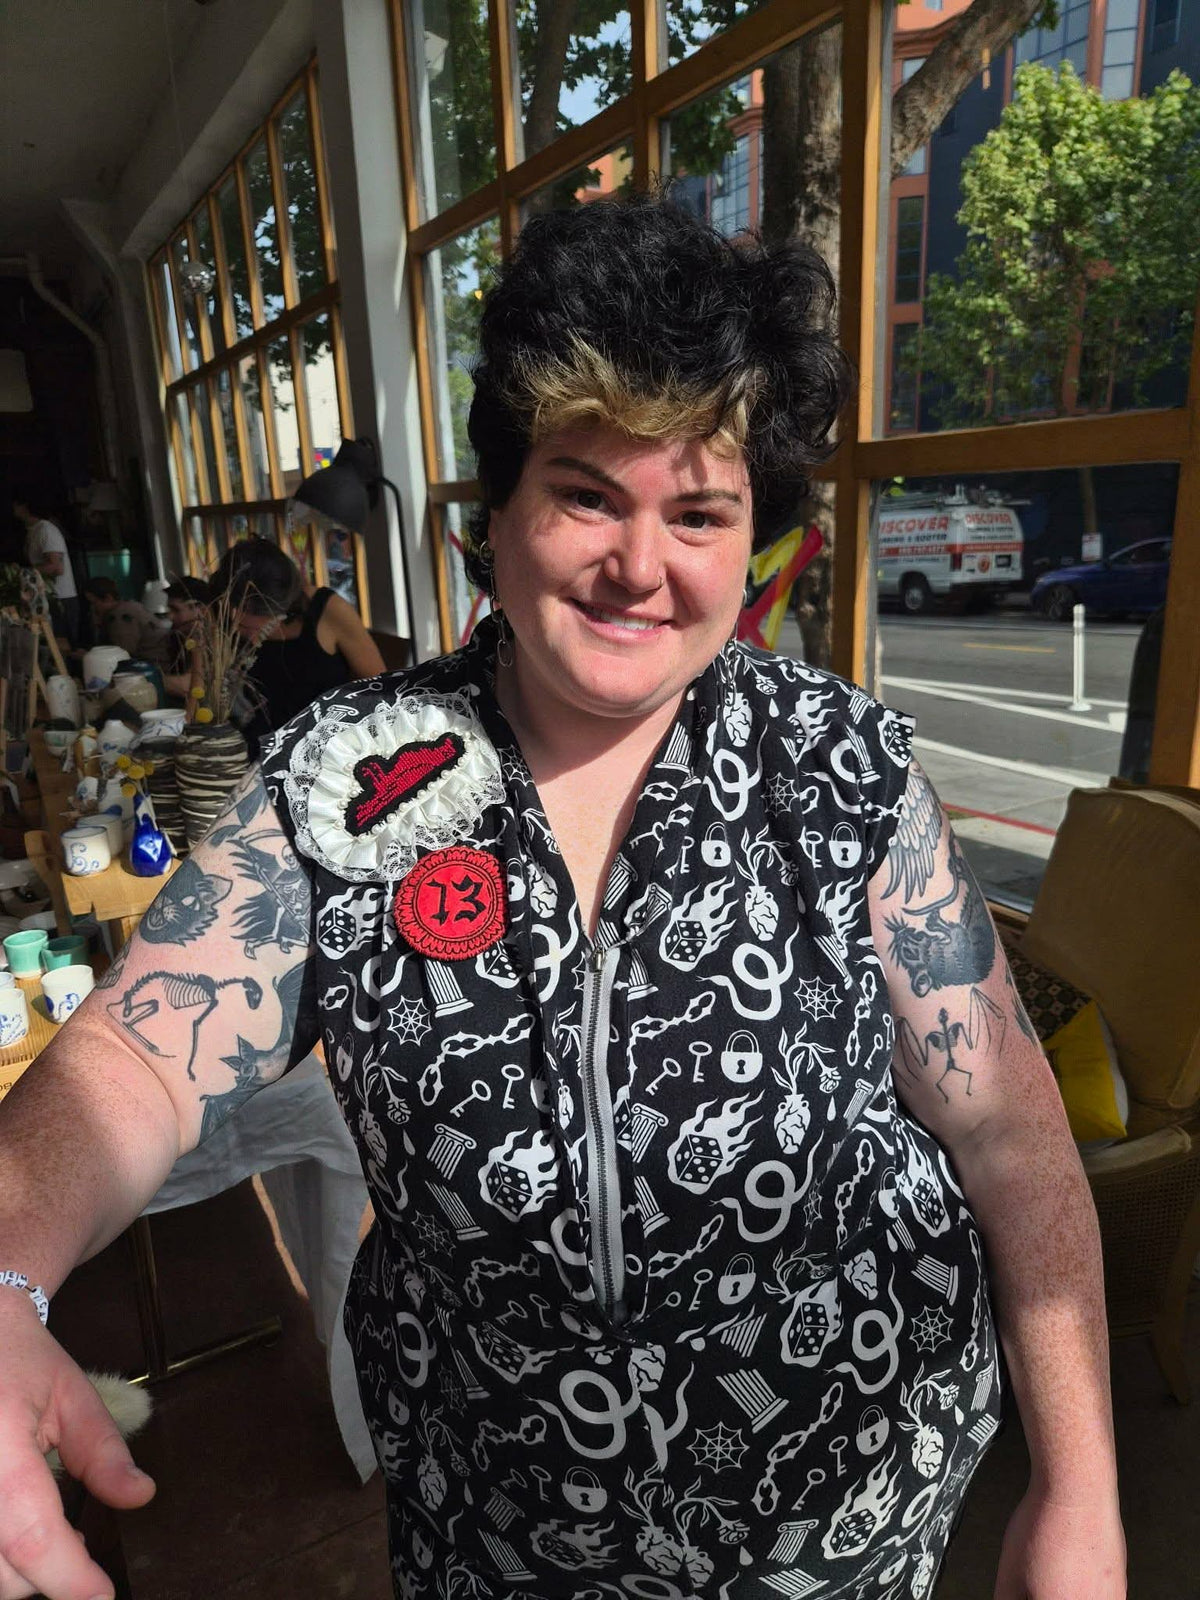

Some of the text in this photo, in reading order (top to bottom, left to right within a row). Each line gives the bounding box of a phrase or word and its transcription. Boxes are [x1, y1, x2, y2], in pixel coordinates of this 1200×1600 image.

[880, 515, 949, 534] ISCOVER
[965, 512, 1012, 525] DISCOVER
[425, 874, 487, 926] 13
